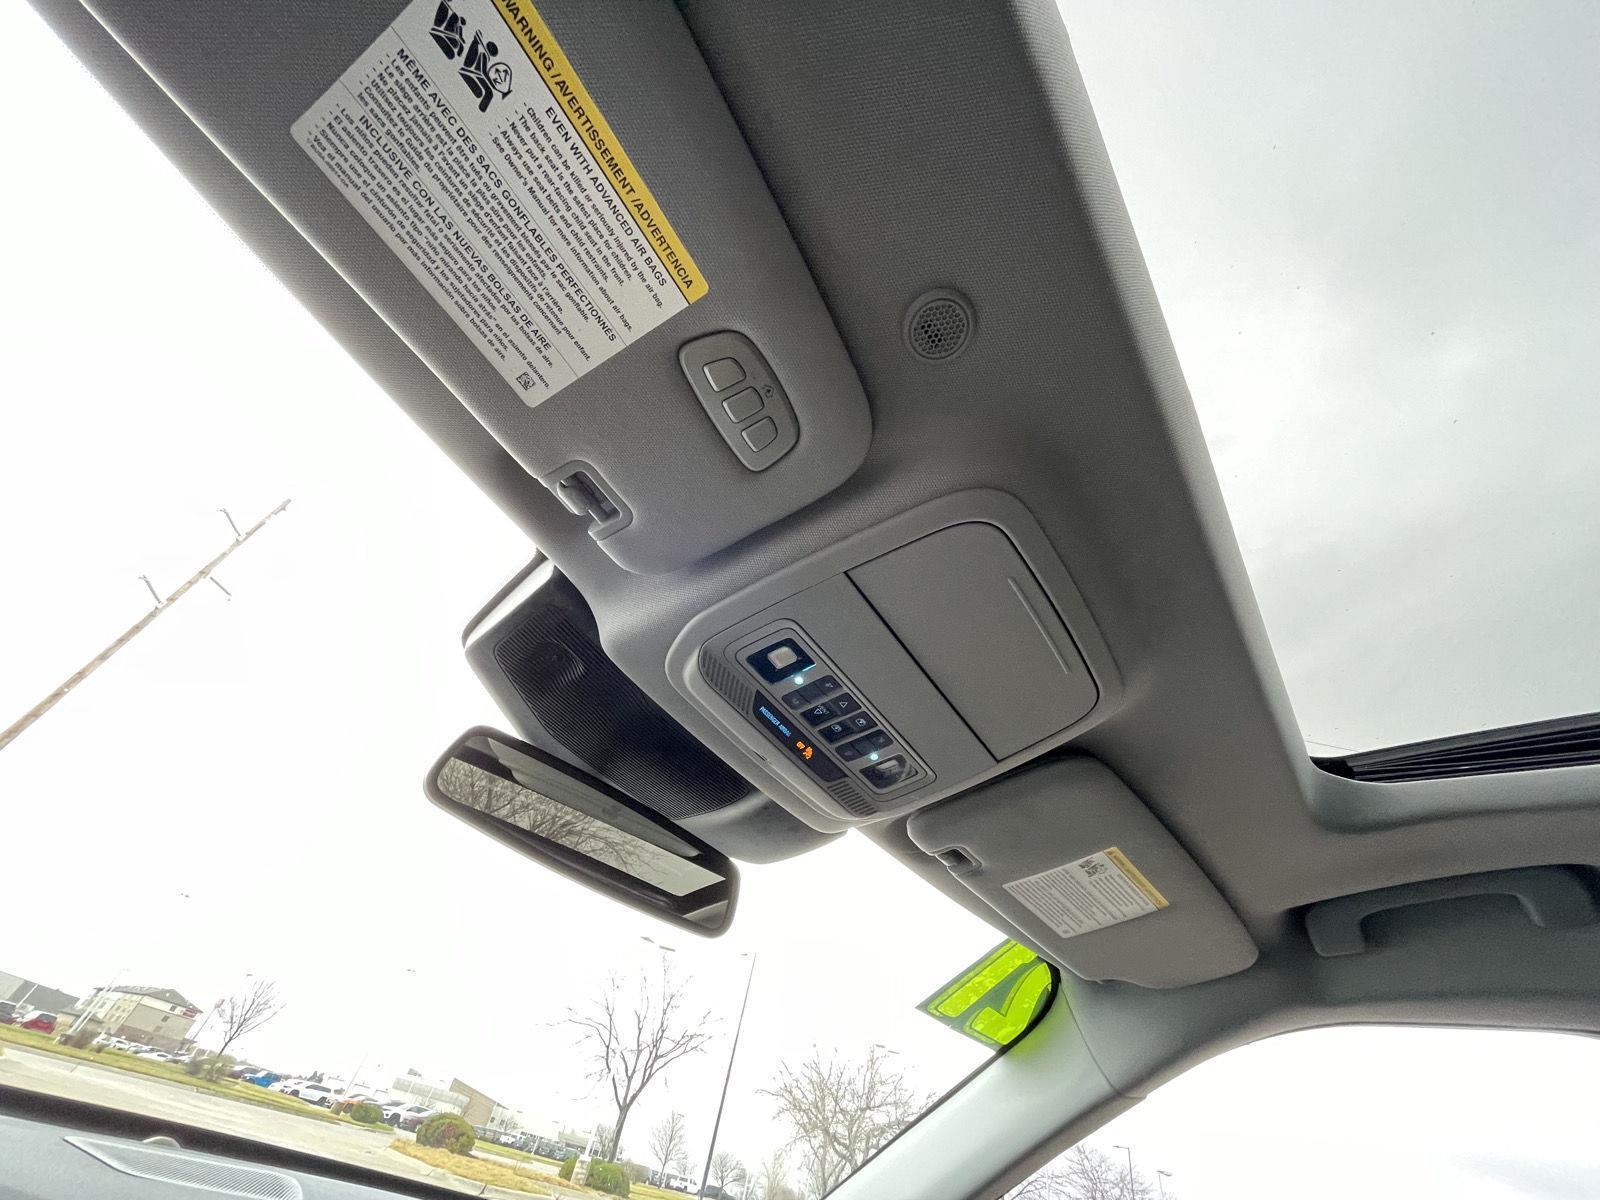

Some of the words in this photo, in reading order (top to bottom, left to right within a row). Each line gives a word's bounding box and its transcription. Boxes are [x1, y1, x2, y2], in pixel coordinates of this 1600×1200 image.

[508, 121, 528, 147] Never
[524, 146, 539, 164] put
[498, 128, 524, 162] Always
[521, 160, 534, 176] use
[532, 174, 548, 194] seat
[544, 192, 562, 214] belts
[558, 212, 572, 229] and
[569, 227, 586, 247] child
[517, 114, 532, 133] The
[528, 131, 546, 154] back
[543, 153, 559, 173] seat
[556, 171, 565, 181] is
[562, 180, 575, 195] the
[571, 194, 591, 219] safest
[586, 218, 605, 241] place
[602, 238, 613, 251] for
[536, 162, 543, 170] a
[396, 45, 432, 91] MÊME
[427, 89, 458, 127] AVEC
[454, 126, 478, 154] DES
[475, 153, 503, 189] SACS
[500, 188, 558, 263] GONFLABLES
[555, 261, 617, 341] PERFECTIONNÉS
[525, 106, 553, 144] Children
[550, 143, 563, 160] can
[560, 158, 572, 171] be
[568, 170, 587, 194] killed
[583, 193, 592, 203] or
[588, 202, 616, 238] seriously
[611, 235, 633, 263] injured
[628, 260, 639, 272] by
[636, 270, 648, 283] the
[644, 282, 654, 294] air
[539, 168, 573, 213] rear-facing
[544, 105, 572, 143] EVEN
[568, 142, 593, 175] WITH
[589, 173, 634, 237] ADVANCED
[630, 236, 647, 256] AIR
[643, 255, 667, 286] BAGS
[358, 114, 413, 180] INCLUSIVE
[411, 179, 435, 207] CON
[432, 206, 454, 231] LAS
[452, 229, 489, 273] NUEVAS
[486, 272, 522, 314] BOLSAS
[519, 313, 533, 328] DE
[530, 327, 551, 350] AIRE
[491, 135, 506, 154] See
[526, 185, 550, 215] Manual
[547, 214, 558, 227] for
[555, 227, 571, 247] more
[569, 245, 600, 286] information
[597, 285, 614, 305] about
[611, 304, 621, 315] air
[570, 210, 586, 231] child
[583, 229, 598, 247] seat
[594, 246, 604, 255] in
[600, 254, 612, 268] the
